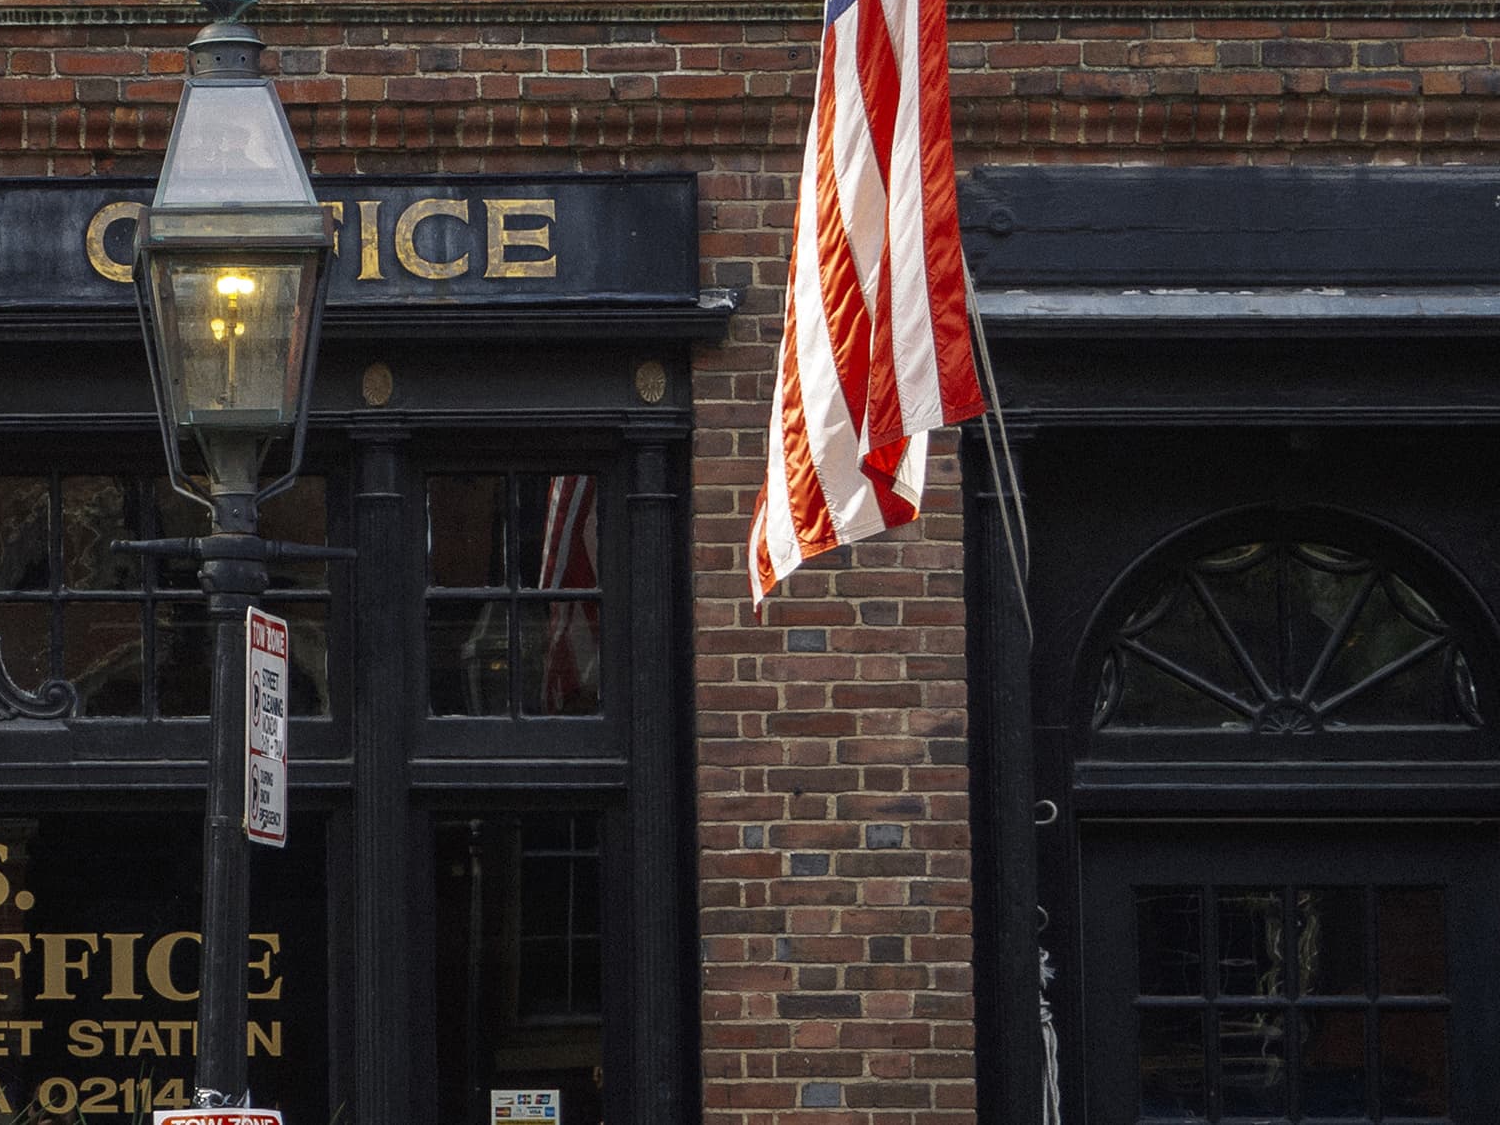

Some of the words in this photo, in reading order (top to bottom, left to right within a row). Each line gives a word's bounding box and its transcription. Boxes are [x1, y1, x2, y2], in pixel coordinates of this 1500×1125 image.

[86, 198, 557, 284] OICE
[252, 621, 265, 647] TOW
[266, 626, 284, 655] ZONE
[262, 668, 278, 691] STREET
[262, 692, 284, 718] CLEANING
[67, 1019, 282, 1058] STATIN
[38, 1077, 191, 1114] 02114
